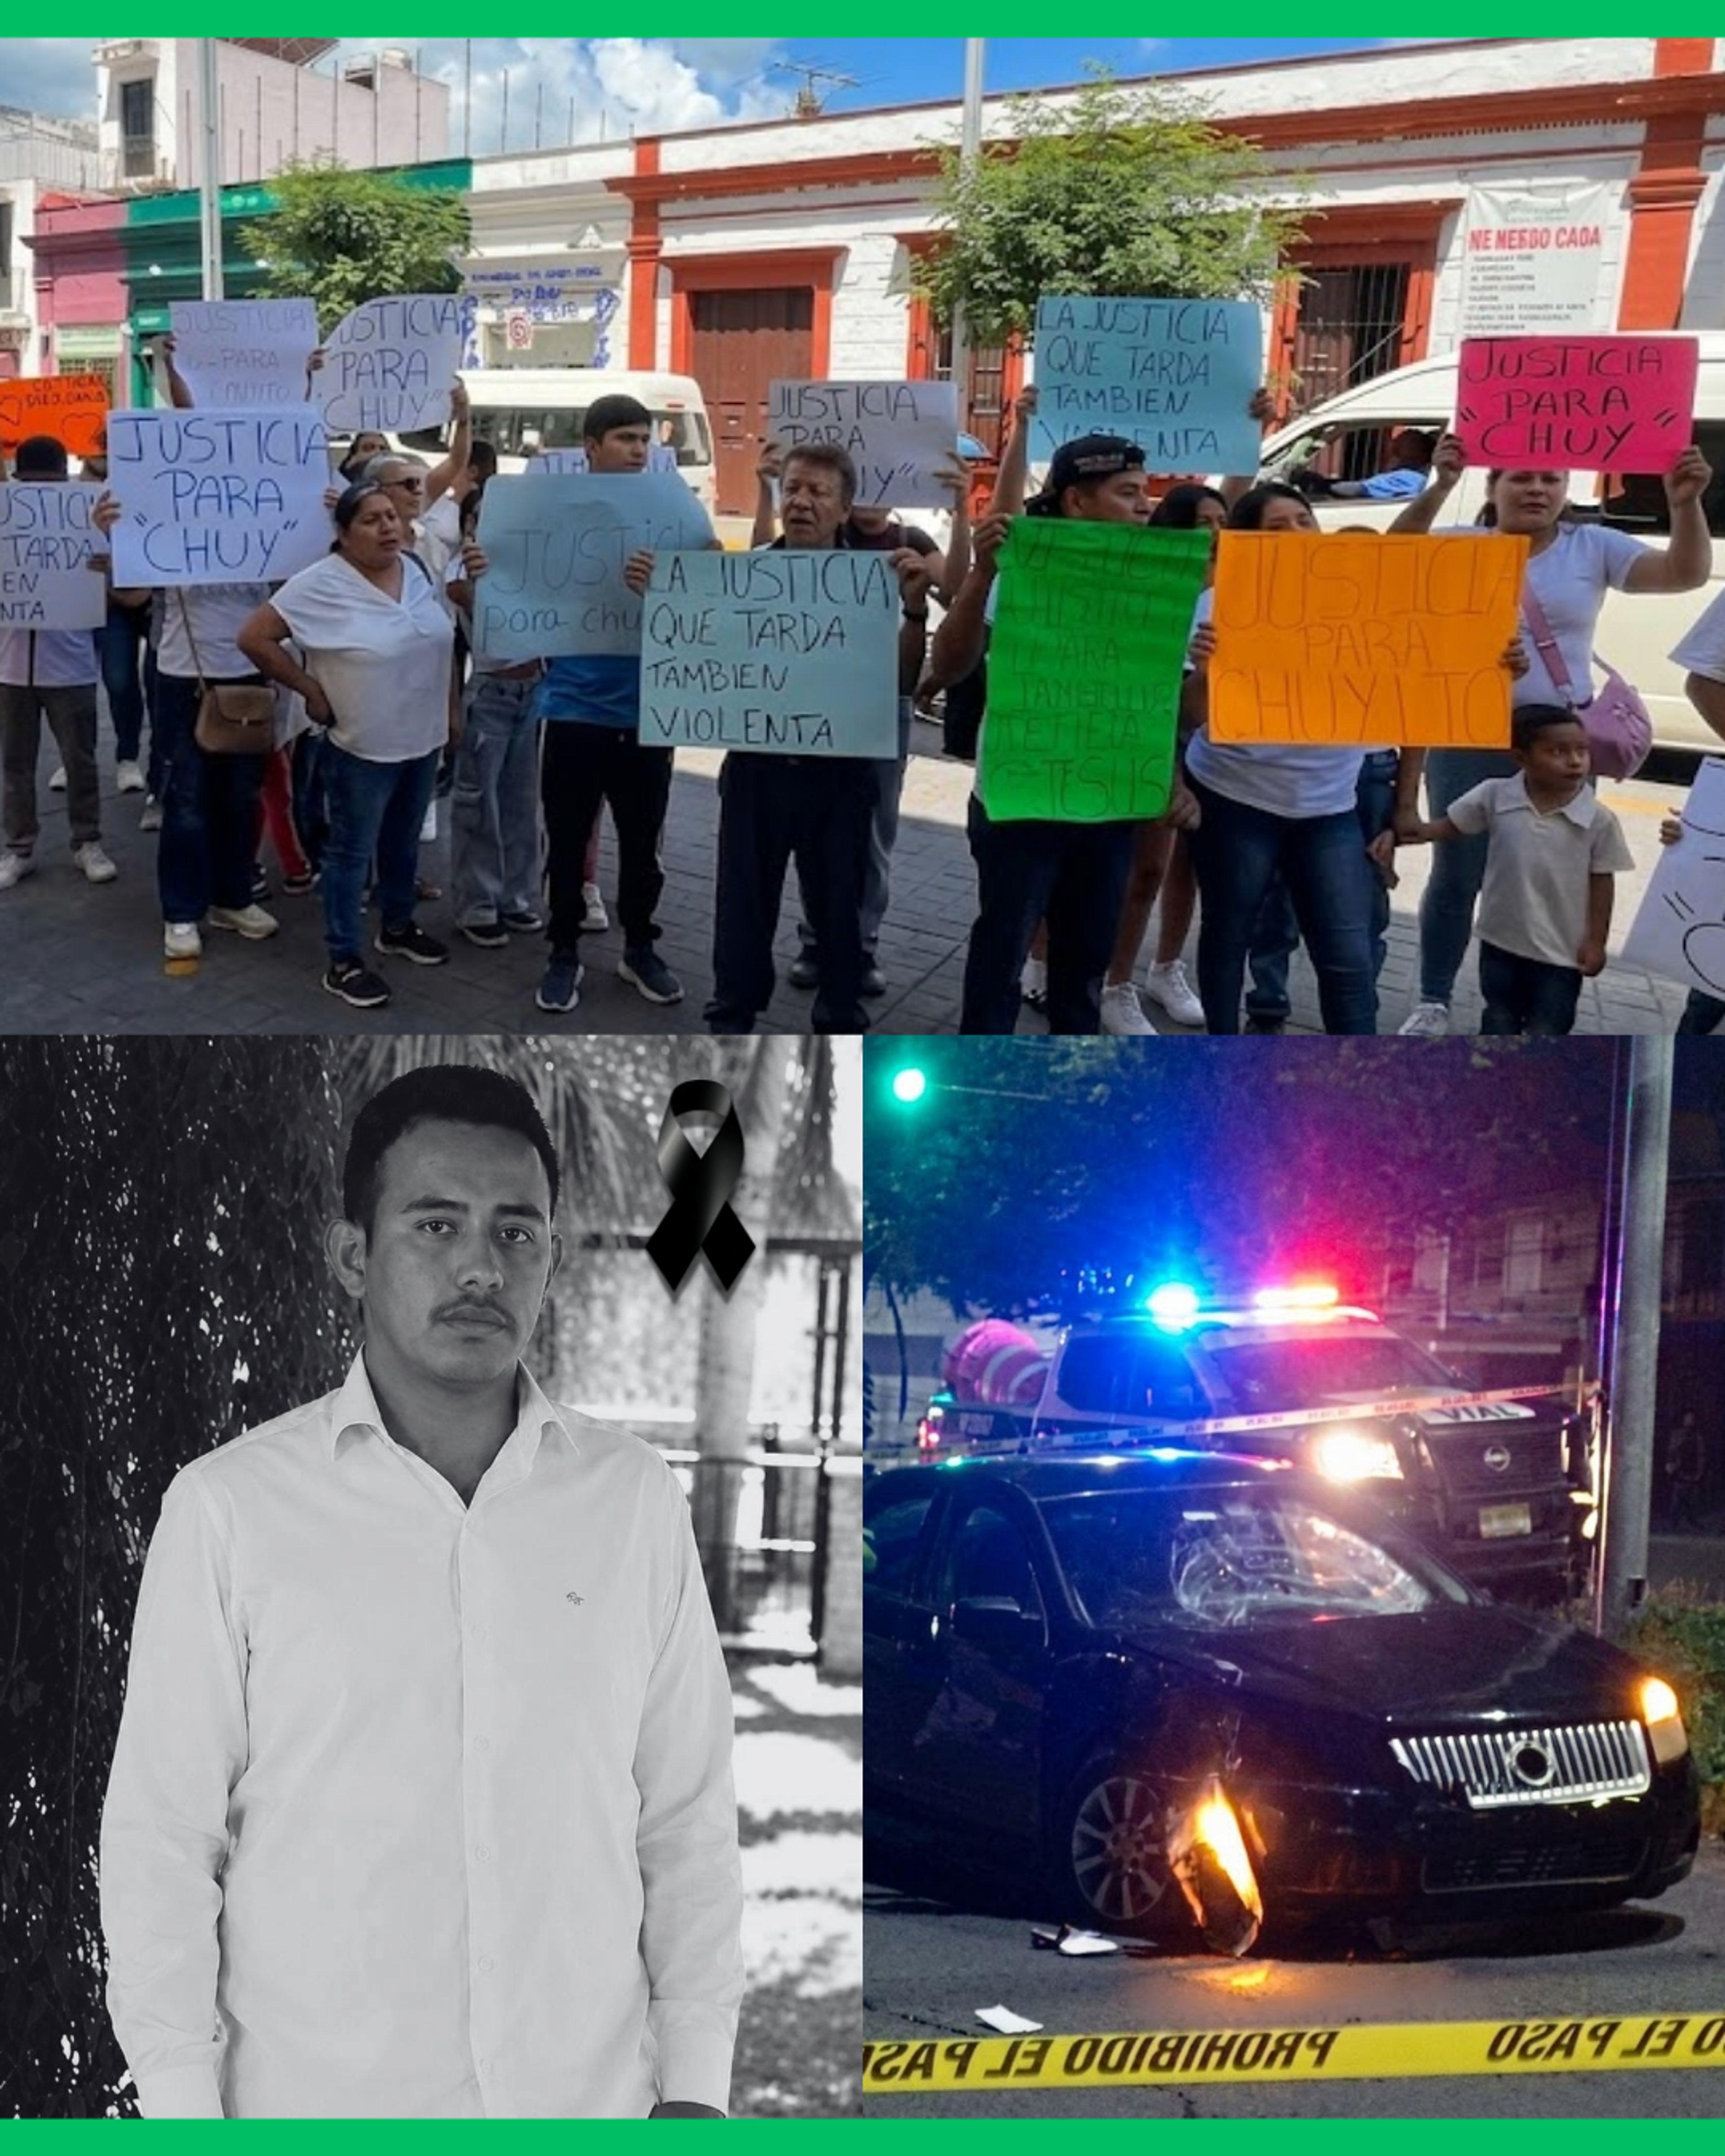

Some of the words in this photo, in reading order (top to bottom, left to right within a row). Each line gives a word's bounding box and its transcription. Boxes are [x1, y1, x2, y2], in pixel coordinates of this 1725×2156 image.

[340, 299, 460, 344] USTICIA
[1038, 301, 1075, 331] LA
[1083, 301, 1229, 345] JUSTICIA
[331, 348, 429, 392] PARA
[1047, 335, 1105, 377] QUE
[1123, 346, 1210, 386] TARDA
[1465, 340, 1663, 384] JUSTICIA
[769, 385, 918, 421] JUSTICIA
[1045, 383, 1191, 413] TAMBIEN
[1492, 386, 1630, 420] PARA
[113, 417, 331, 465] JUSTICIA
[153, 470, 284, 523] PARA
[705, 553, 889, 610] JUSTICIA
[1219, 535, 1522, 629] JUSTICIA
[650, 603, 717, 649] QUE
[734, 609, 846, 653] TARDA
[1305, 619, 1432, 668] PARA
[646, 656, 789, 694] TAMBIEN
[650, 706, 834, 749] VIOLENTA
[1214, 667, 1509, 744] CHUYITO
[1440, 1403, 1520, 1422] VIAL
